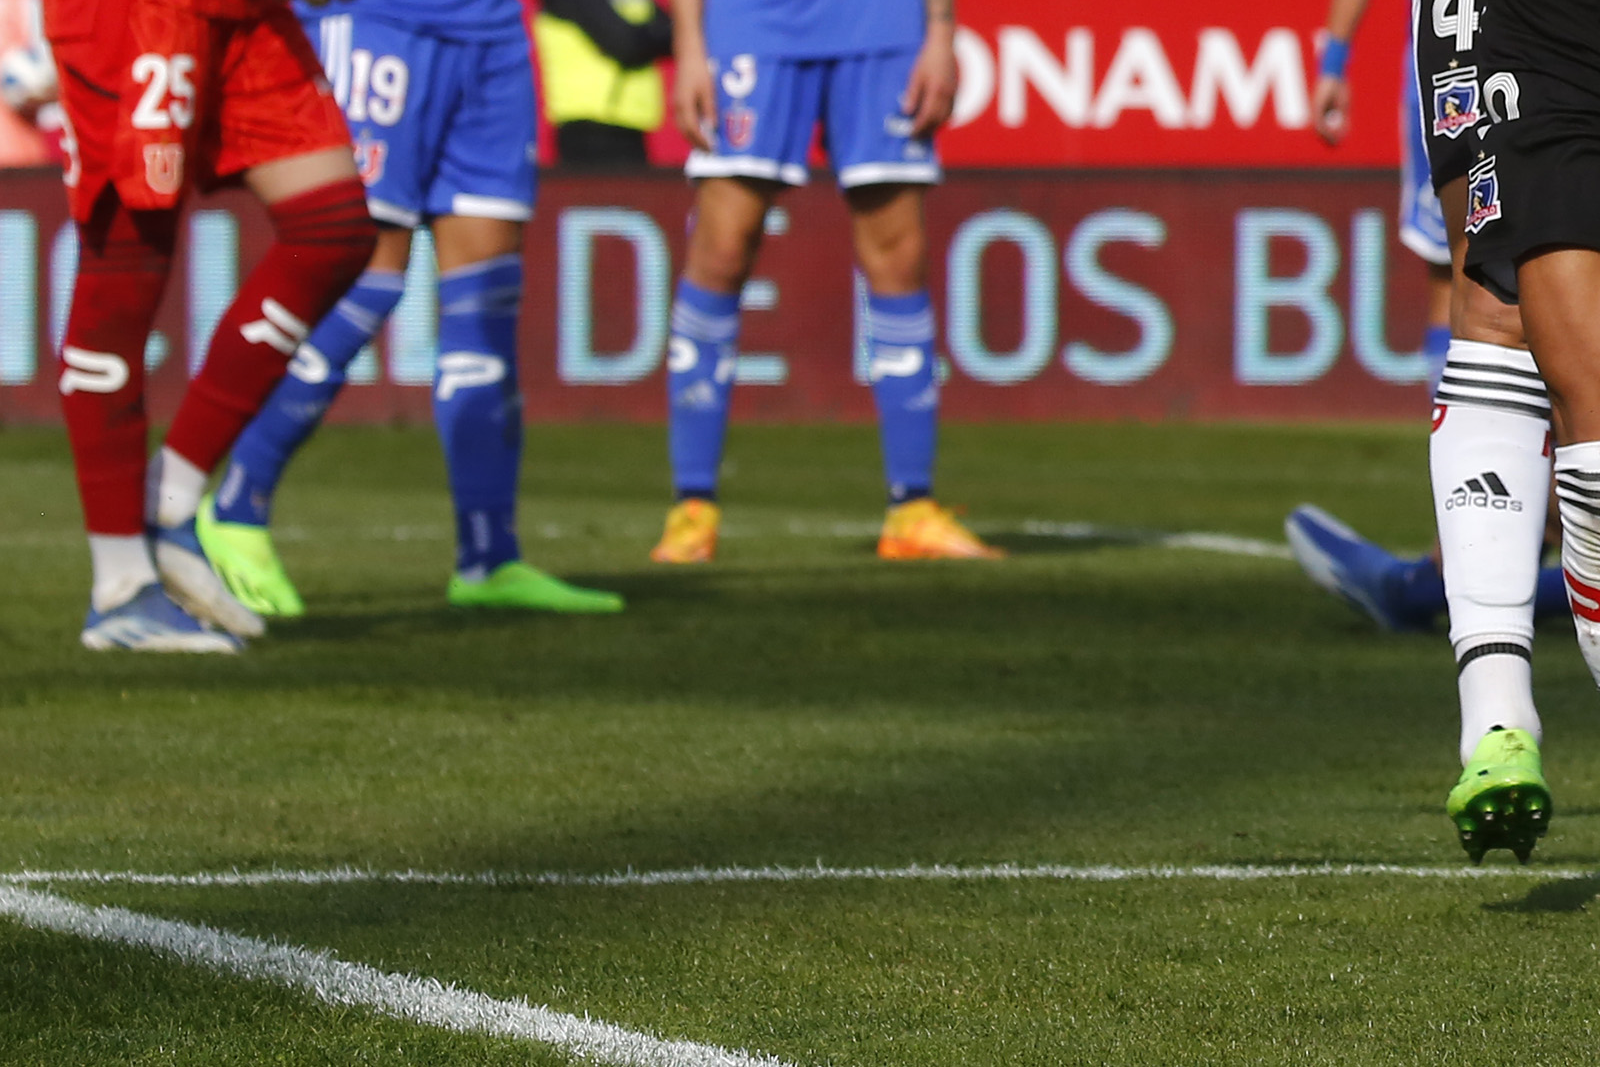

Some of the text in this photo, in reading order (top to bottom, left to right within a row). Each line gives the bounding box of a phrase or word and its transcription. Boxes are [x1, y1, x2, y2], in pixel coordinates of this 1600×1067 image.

[131, 53, 195, 130] 25
[348, 49, 409, 127] 19
[853, 207, 1175, 386] OS
[1444, 492, 1523, 513] adidas
